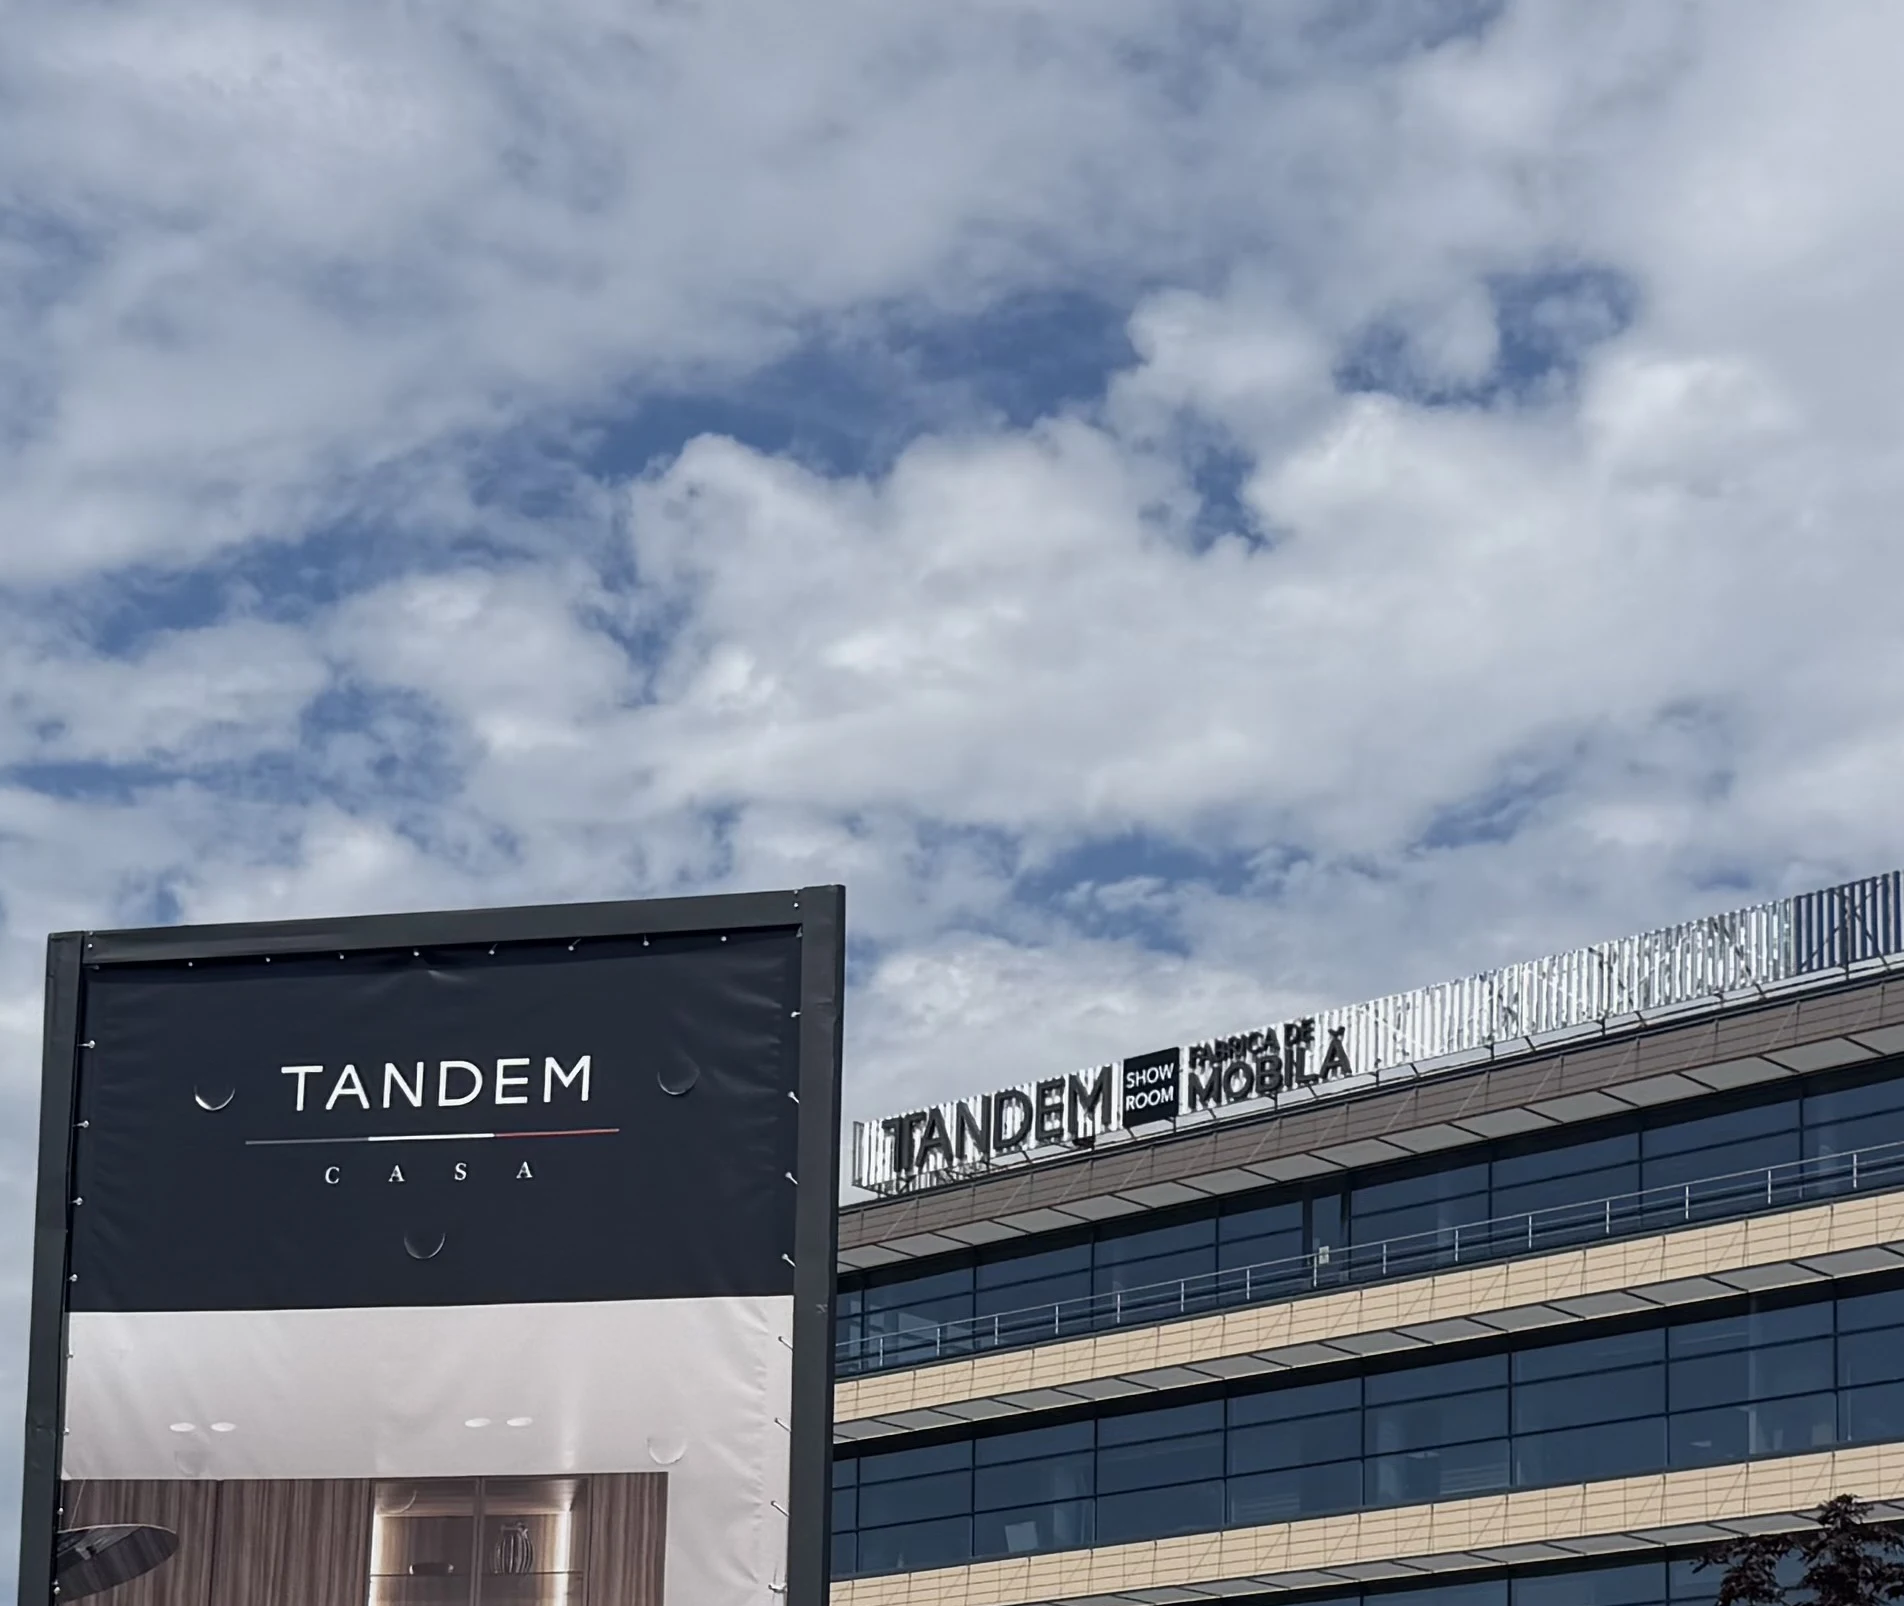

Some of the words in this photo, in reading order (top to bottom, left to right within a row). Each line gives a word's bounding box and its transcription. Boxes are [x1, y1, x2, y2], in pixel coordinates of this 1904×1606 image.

[1188, 1026, 1353, 1110] MOBILĂ
[1189, 1026, 1280, 1069] FABRICA
[1284, 1017, 1315, 1047] DE
[280, 1054, 592, 1112] TANDEM
[1125, 1062, 1175, 1090] SHOW
[1125, 1085, 1175, 1112] ROOM
[882, 1065, 1114, 1173] TANDEM
[324, 1160, 533, 1185] CASA
